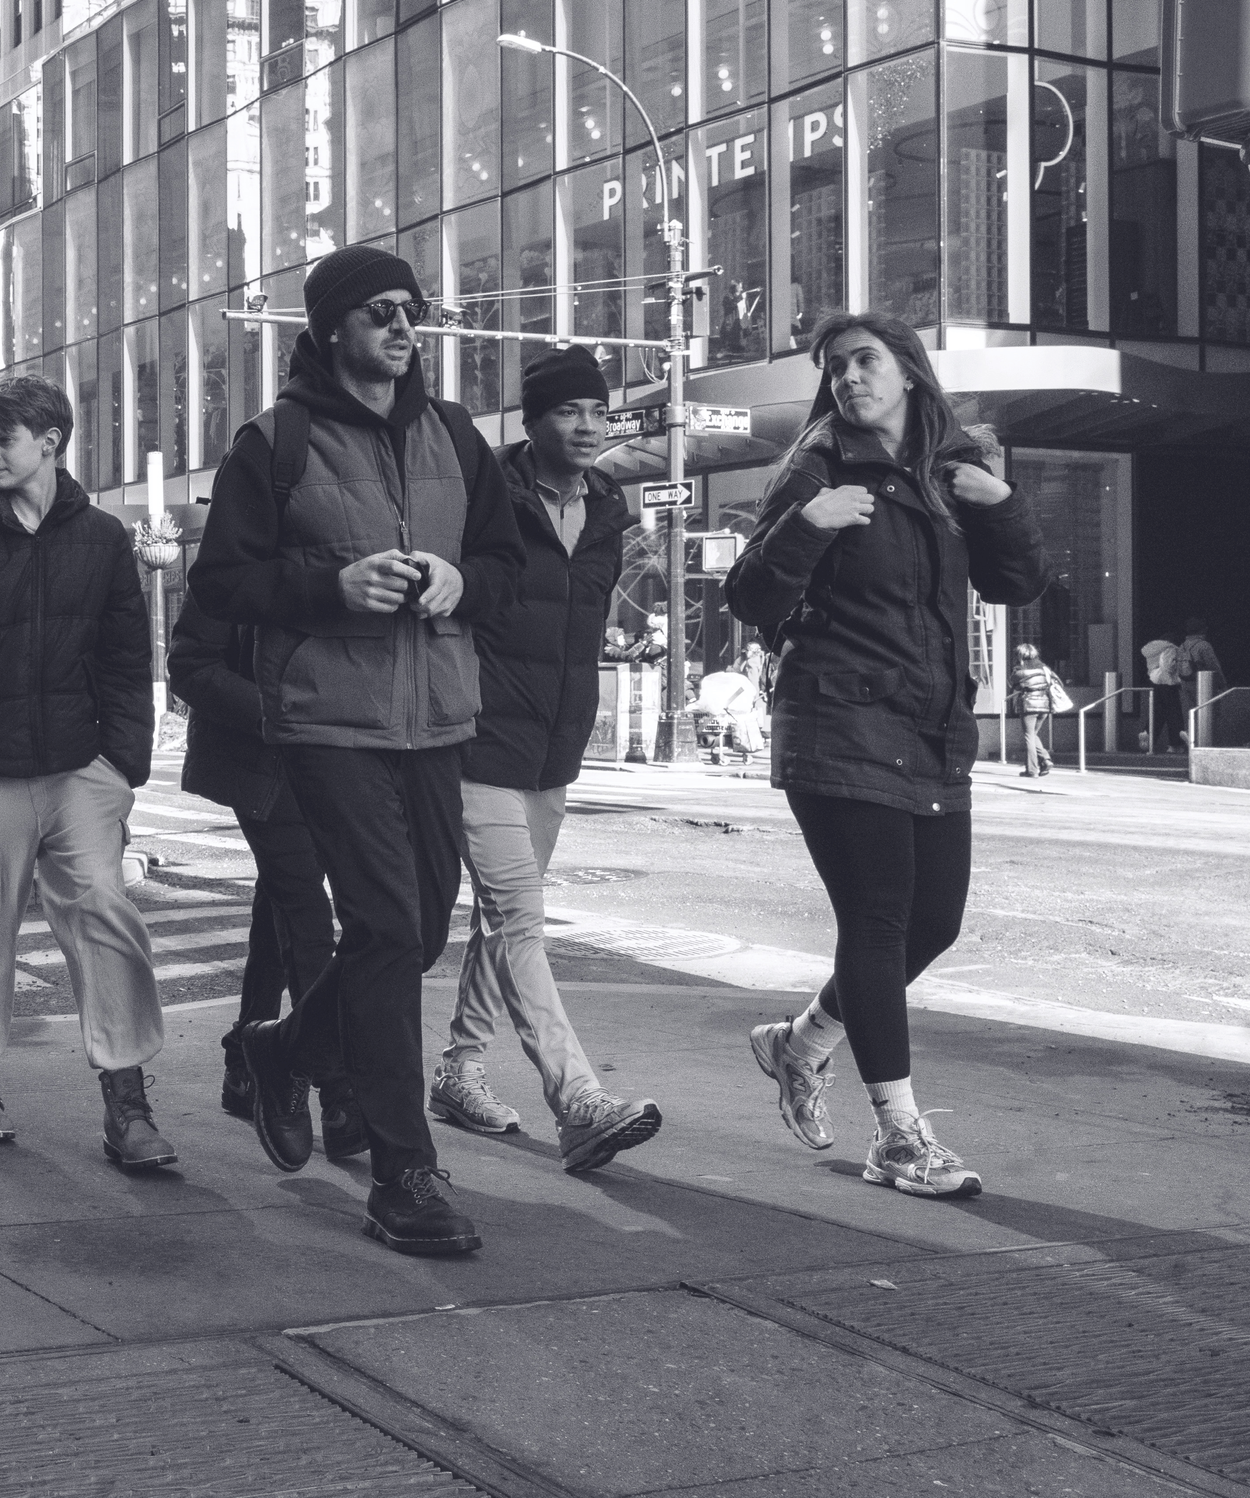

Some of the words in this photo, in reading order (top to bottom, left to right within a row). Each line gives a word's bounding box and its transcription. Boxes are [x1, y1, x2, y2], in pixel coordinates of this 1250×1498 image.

[606, 419, 642, 432] Broadway
[647, 492, 661, 502] ONE
[668, 490, 683, 500] WAY
